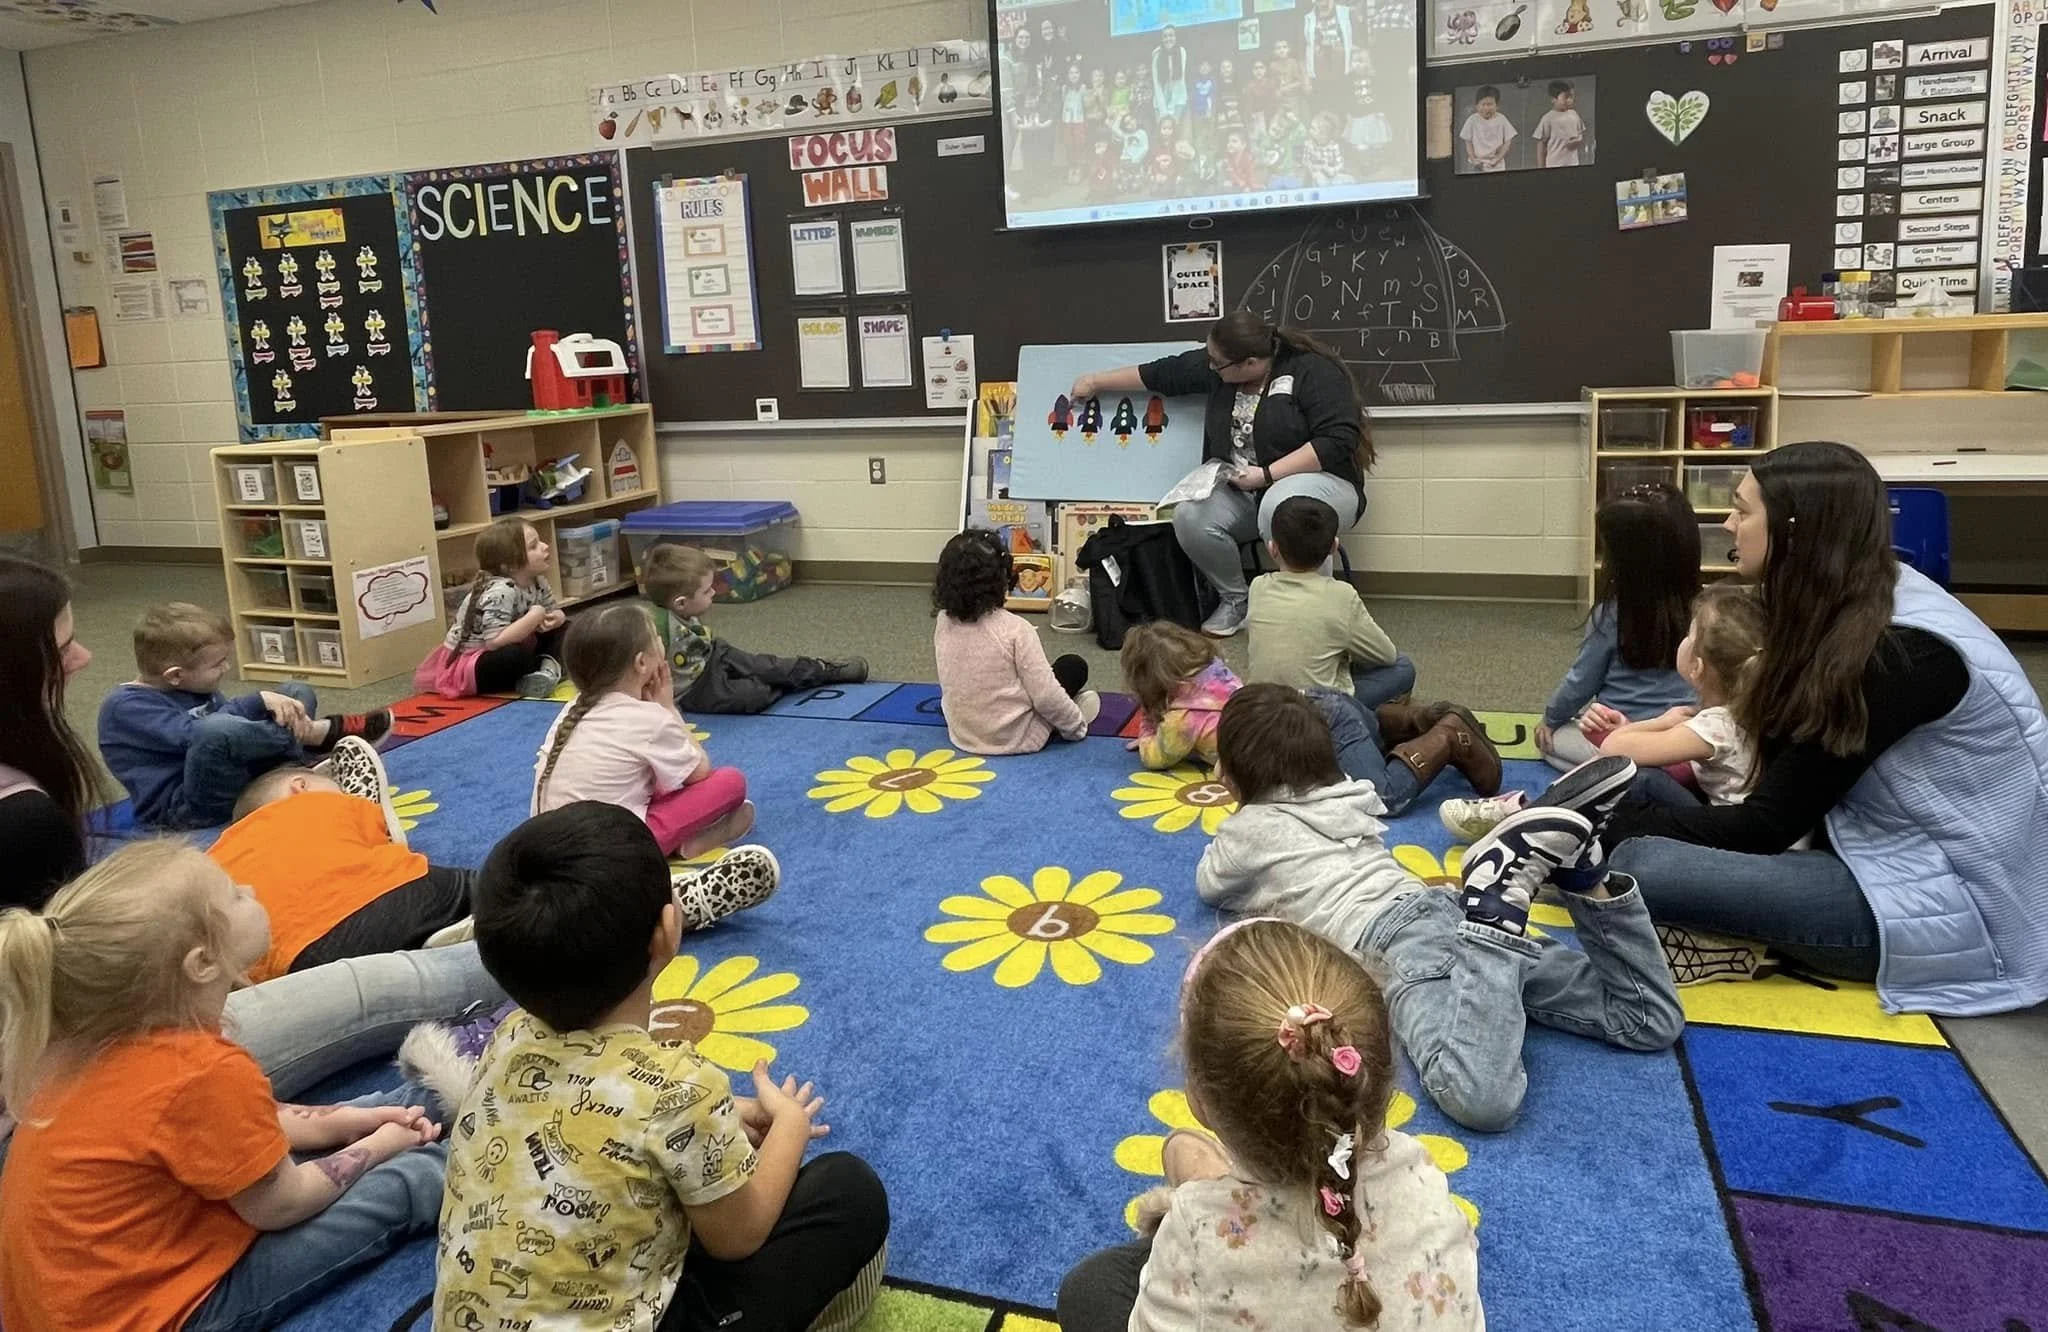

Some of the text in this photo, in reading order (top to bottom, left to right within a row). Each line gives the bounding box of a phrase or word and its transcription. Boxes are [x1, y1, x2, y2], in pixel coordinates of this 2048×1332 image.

[1919, 44, 1972, 62] Arrival
[622, 84, 637, 101] Bb
[644, 80, 661, 97] Cc
[670, 77, 689, 95] Dd
[700, 75, 718, 92] Ee
[728, 71, 744, 88] Ff
[754, 69, 776, 92] Gg
[784, 64, 802, 82] Hh
[813, 60, 827, 79] Ii
[844, 57, 858, 82] Jj
[877, 53, 895, 73] Kk
[907, 47, 918, 68] Ll
[932, 46, 960, 64] Mm
[1918, 108, 1966, 123] Snack
[790, 127, 894, 167] FOCUS
[1907, 138, 1975, 151] Large Group
[804, 167, 886, 202] WALL
[416, 175, 611, 240] SCIENCE
[681, 199, 724, 219] RULES
[1918, 195, 1960, 205] Centers
[793, 226, 836, 241] LETTER:
[1906, 222, 1970, 233] Second Steps
[1306, 243, 1321, 262] G
[1912, 247, 1934, 255] Gross
[1914, 257, 1931, 265] Gym
[1176, 270, 1210, 278] OUTER
[1458, 268, 1470, 287] g
[1902, 276, 1968, 289] Qui Time
[1177, 281, 1210, 289] SPACE
[1341, 278, 1363, 305] N
[1471, 287, 1490, 307] R
[1380, 300, 1401, 325] T
[863, 319, 904, 334] SHAPE:
[794, 689, 845, 707] P
[567, 1073, 596, 1087] ROLL
[508, 1092, 549, 1104] AWAITS
[586, 1101, 624, 1118] ROCK
[1767, 1095, 1926, 1149] Y
[525, 1131, 554, 1181] TEAM
[553, 1182, 592, 1202] YOU
[541, 1193, 611, 1224] ROCK!
